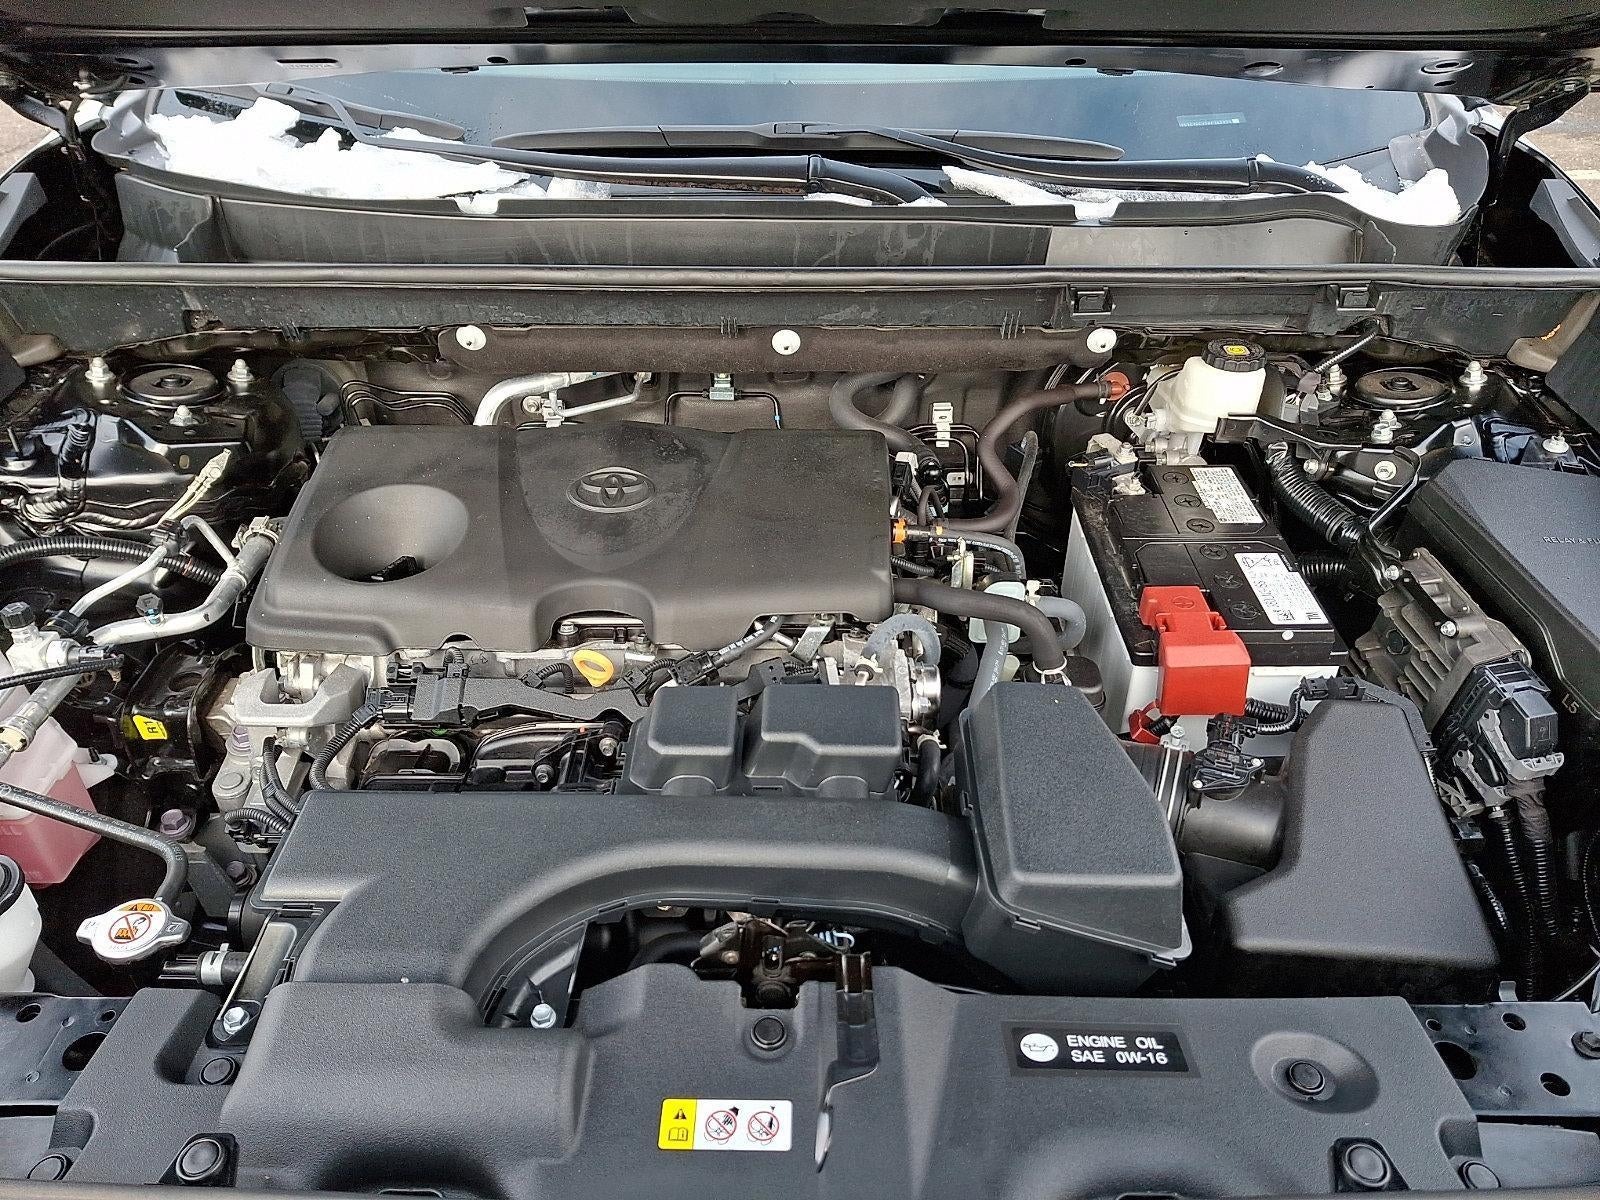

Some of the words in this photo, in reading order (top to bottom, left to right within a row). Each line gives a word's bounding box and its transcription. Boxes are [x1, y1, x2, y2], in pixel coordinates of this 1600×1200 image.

[1542, 536, 1576, 544] RELAY
[1562, 693, 1580, 714] L5
[143, 721, 159, 734] R1
[1066, 1034, 1128, 1049] ENGINE
[1135, 1036, 1164, 1050] OIL
[1071, 1050, 1106, 1063] SAE
[1115, 1052, 1169, 1065] 0W-16
